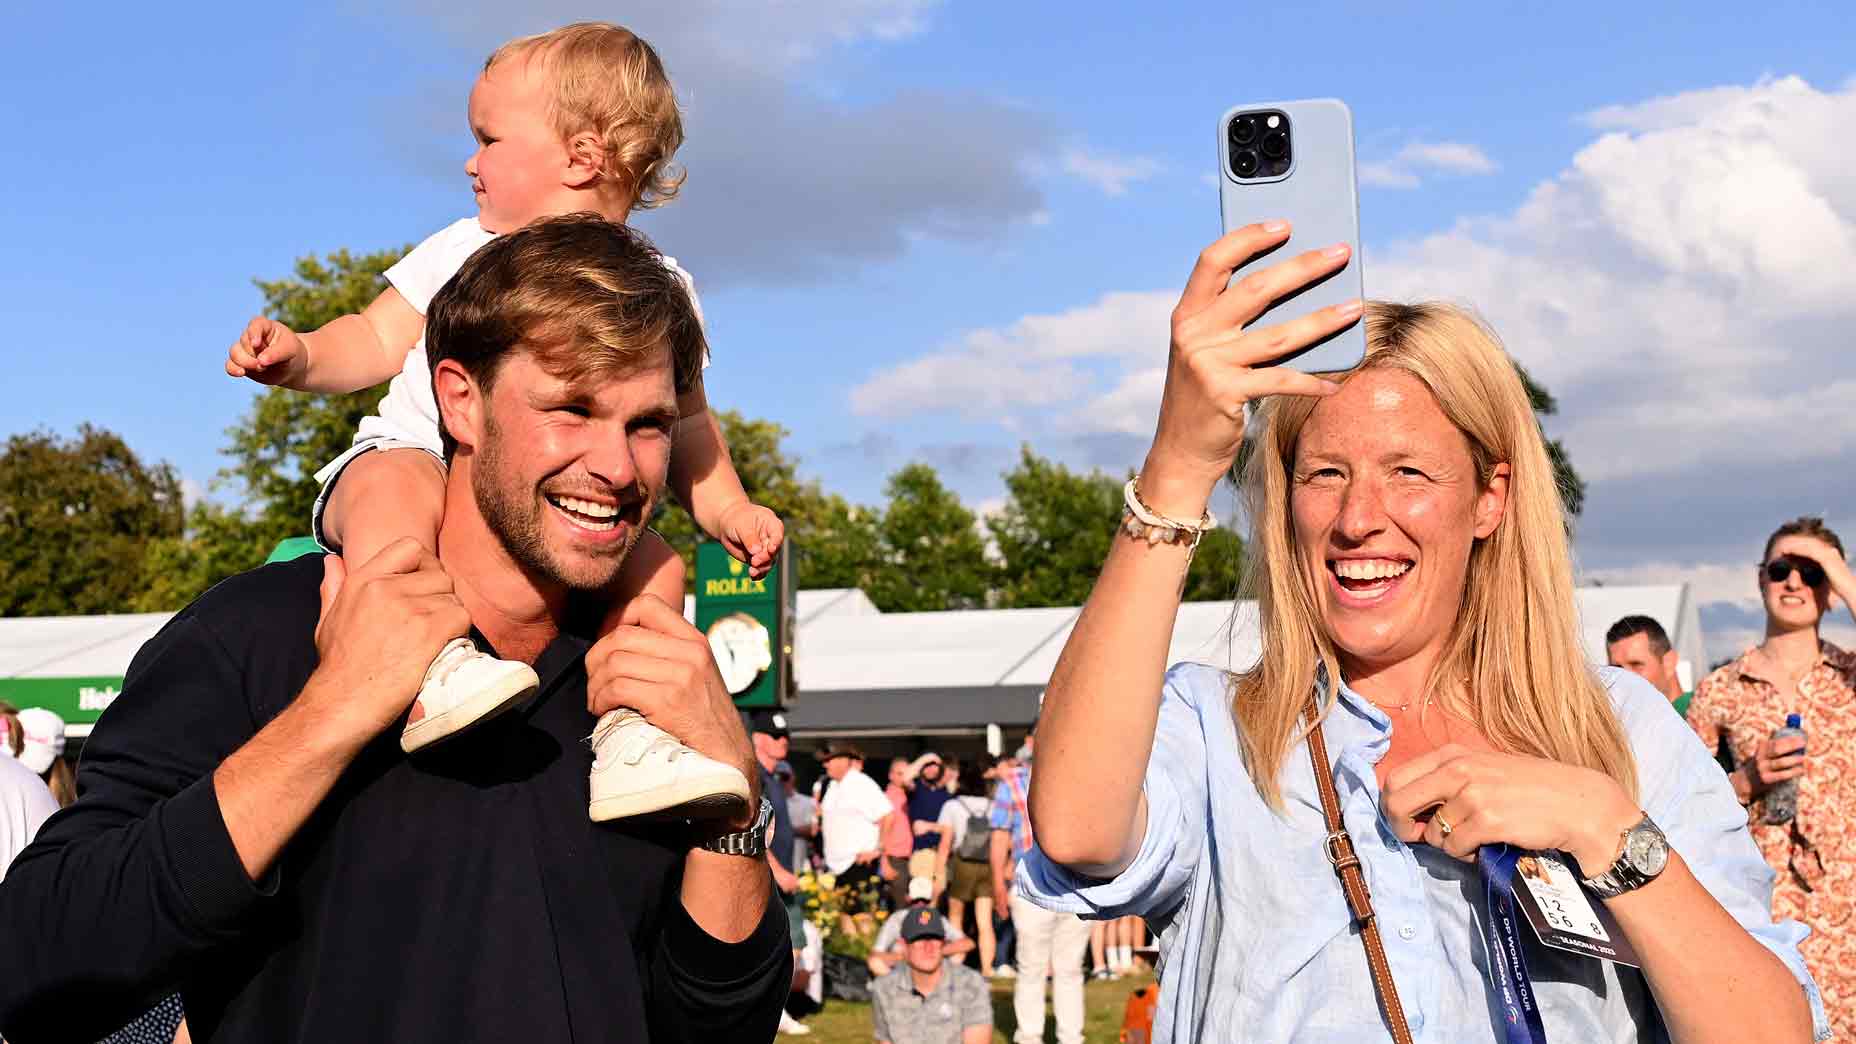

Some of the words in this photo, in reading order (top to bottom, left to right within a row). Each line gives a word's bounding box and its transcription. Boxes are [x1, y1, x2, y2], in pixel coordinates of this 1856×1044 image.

[706, 578, 766, 595] ROLEX
[1552, 899, 1565, 913] 2
[1503, 917, 1512, 935] DP
[1562, 915, 1574, 928] 6
[1590, 922, 1602, 935] 8
[1507, 935, 1523, 981] WORLD
[1519, 982, 1532, 1011] TOUR
